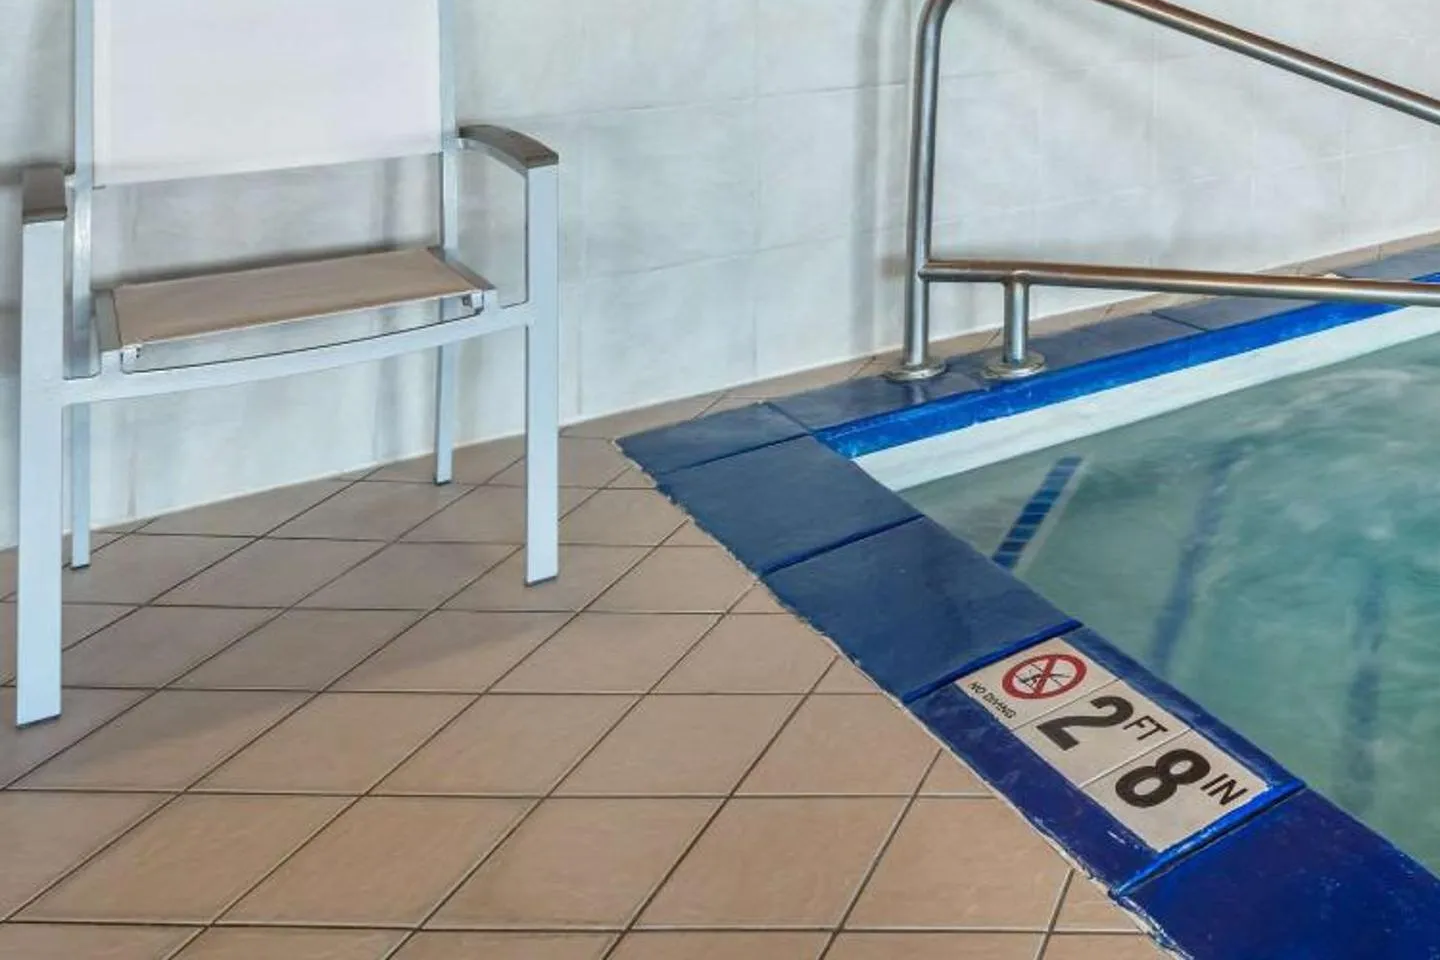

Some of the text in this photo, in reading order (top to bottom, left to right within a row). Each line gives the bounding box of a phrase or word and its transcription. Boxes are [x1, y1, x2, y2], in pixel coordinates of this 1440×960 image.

[967, 681, 986, 694] NO
[1036, 696, 1249, 808] 2 FT 8 IN
